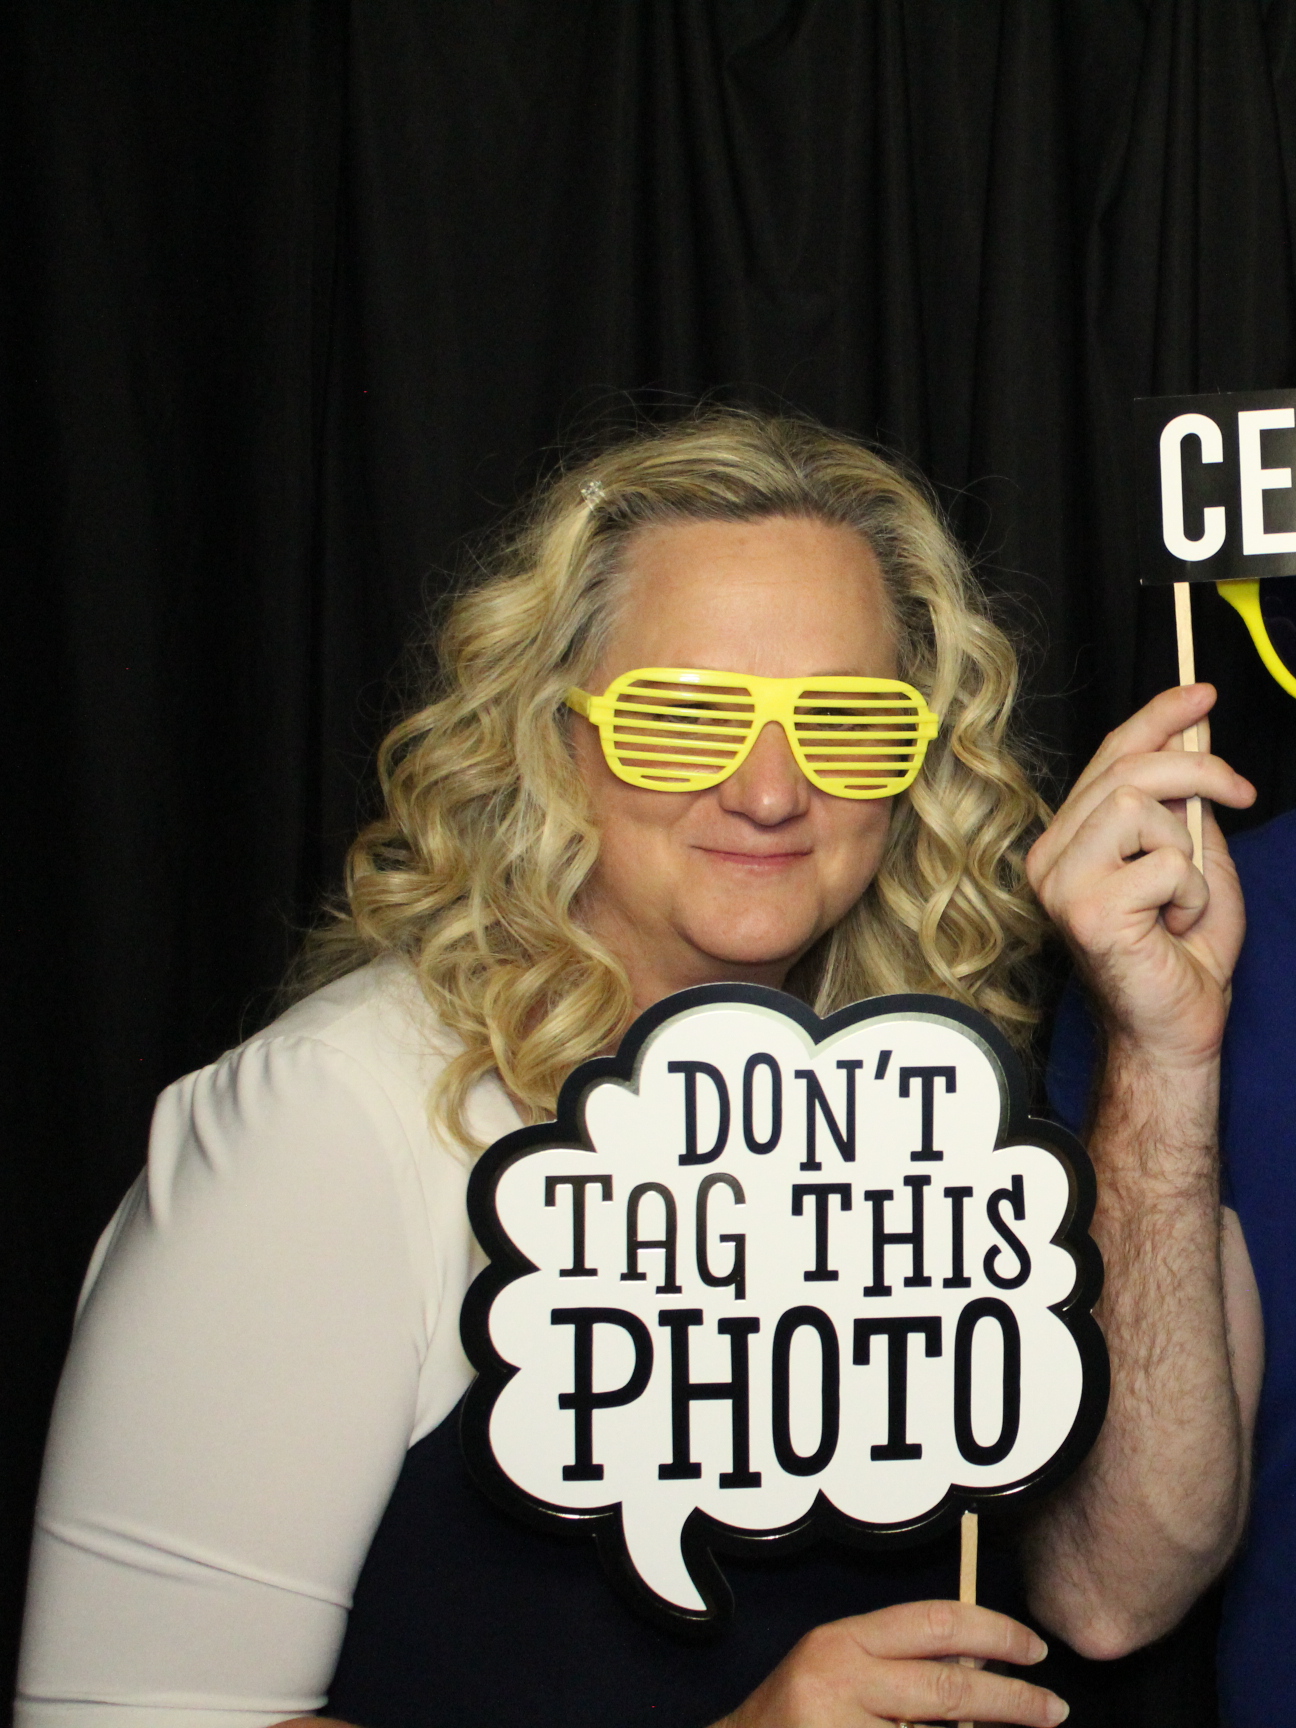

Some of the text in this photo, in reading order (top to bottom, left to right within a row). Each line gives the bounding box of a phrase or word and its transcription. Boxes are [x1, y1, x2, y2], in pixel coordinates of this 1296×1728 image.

[667, 1050, 957, 1171] DON'T
[544, 1172, 1032, 1301] TAG THIS
[550, 1297, 1022, 1490] PHOTO
